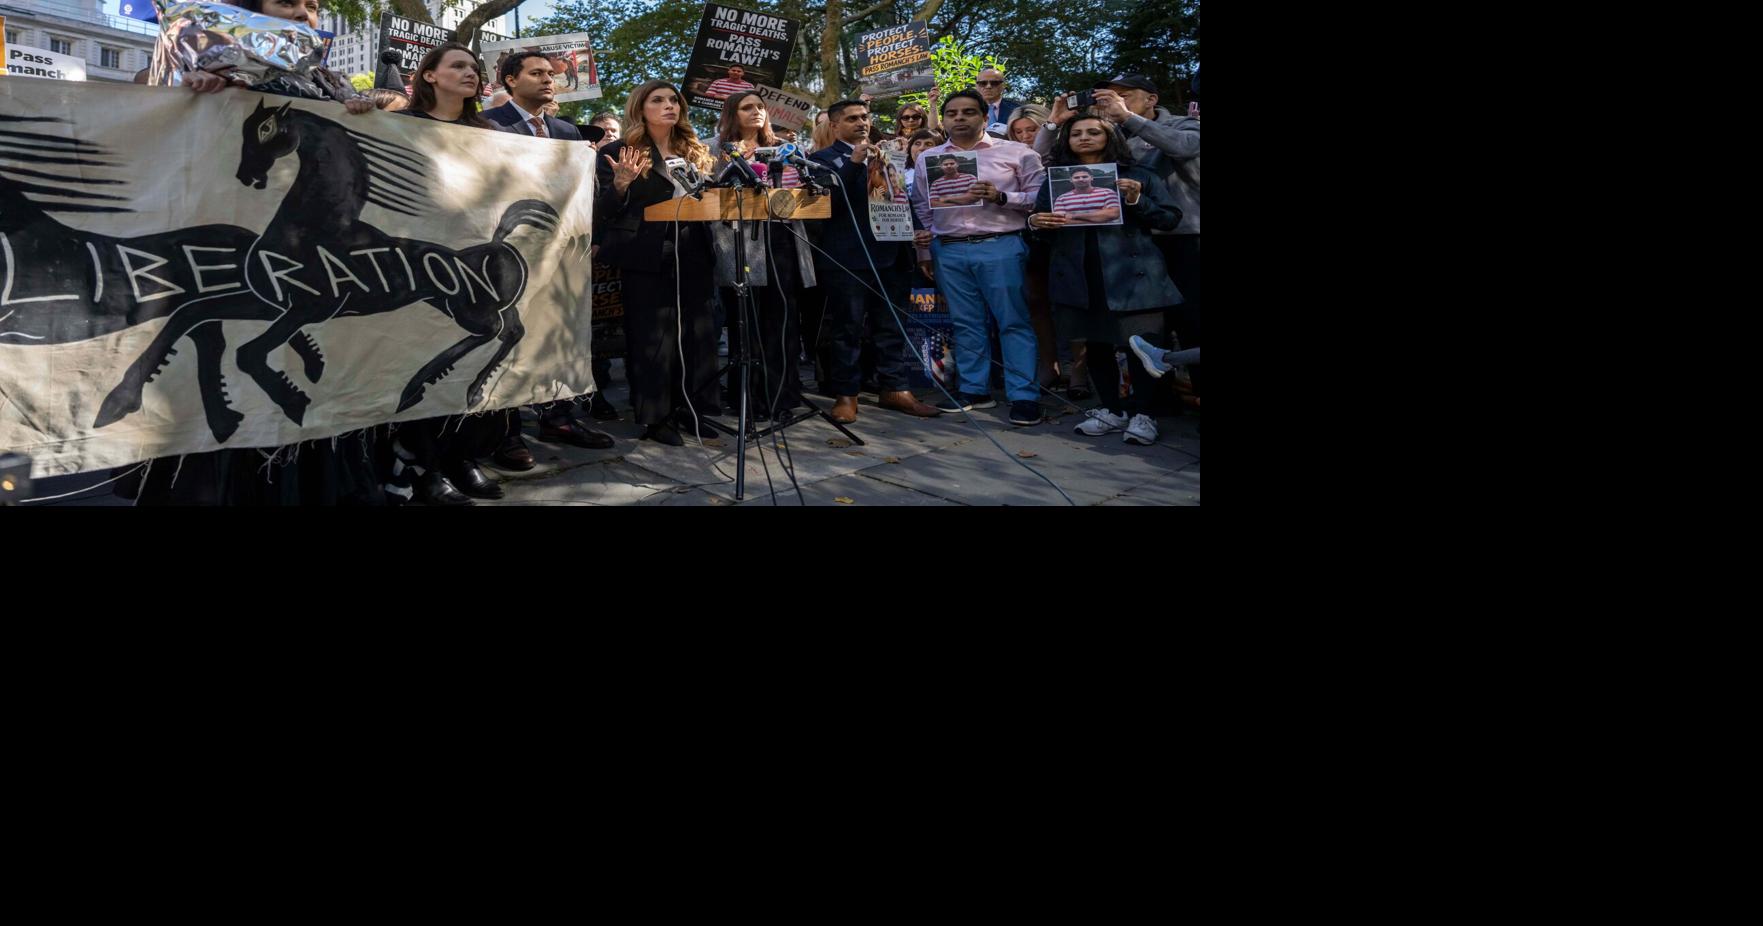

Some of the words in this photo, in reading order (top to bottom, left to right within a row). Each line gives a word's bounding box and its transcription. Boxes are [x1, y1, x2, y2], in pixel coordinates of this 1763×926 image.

[391, 16, 409, 31] NO
[413, 22, 449, 41] MORE
[715, 6, 738, 22] NO
[741, 12, 788, 32] MORE
[388, 27, 419, 42] TRAGIC
[482, 31, 497, 42] NO
[710, 18, 747, 33] TRAGIC
[748, 26, 789, 42] DEATHS,
[861, 24, 909, 43] PROTECT
[406, 43, 432, 54] PASS
[706, 38, 781, 60] ROMANCH'S
[729, 33, 762, 47] PASS
[867, 38, 915, 57] PROTECT
[10, 49, 53, 65] Pass
[719, 50, 762, 67] LAW!
[864, 64, 880, 74] PASS
[916, 53, 929, 61] LAW
[870, 45, 924, 64] HORSES:
[759, 87, 811, 111] DEFEND
[0, 231, 500, 303] LIBERATION
